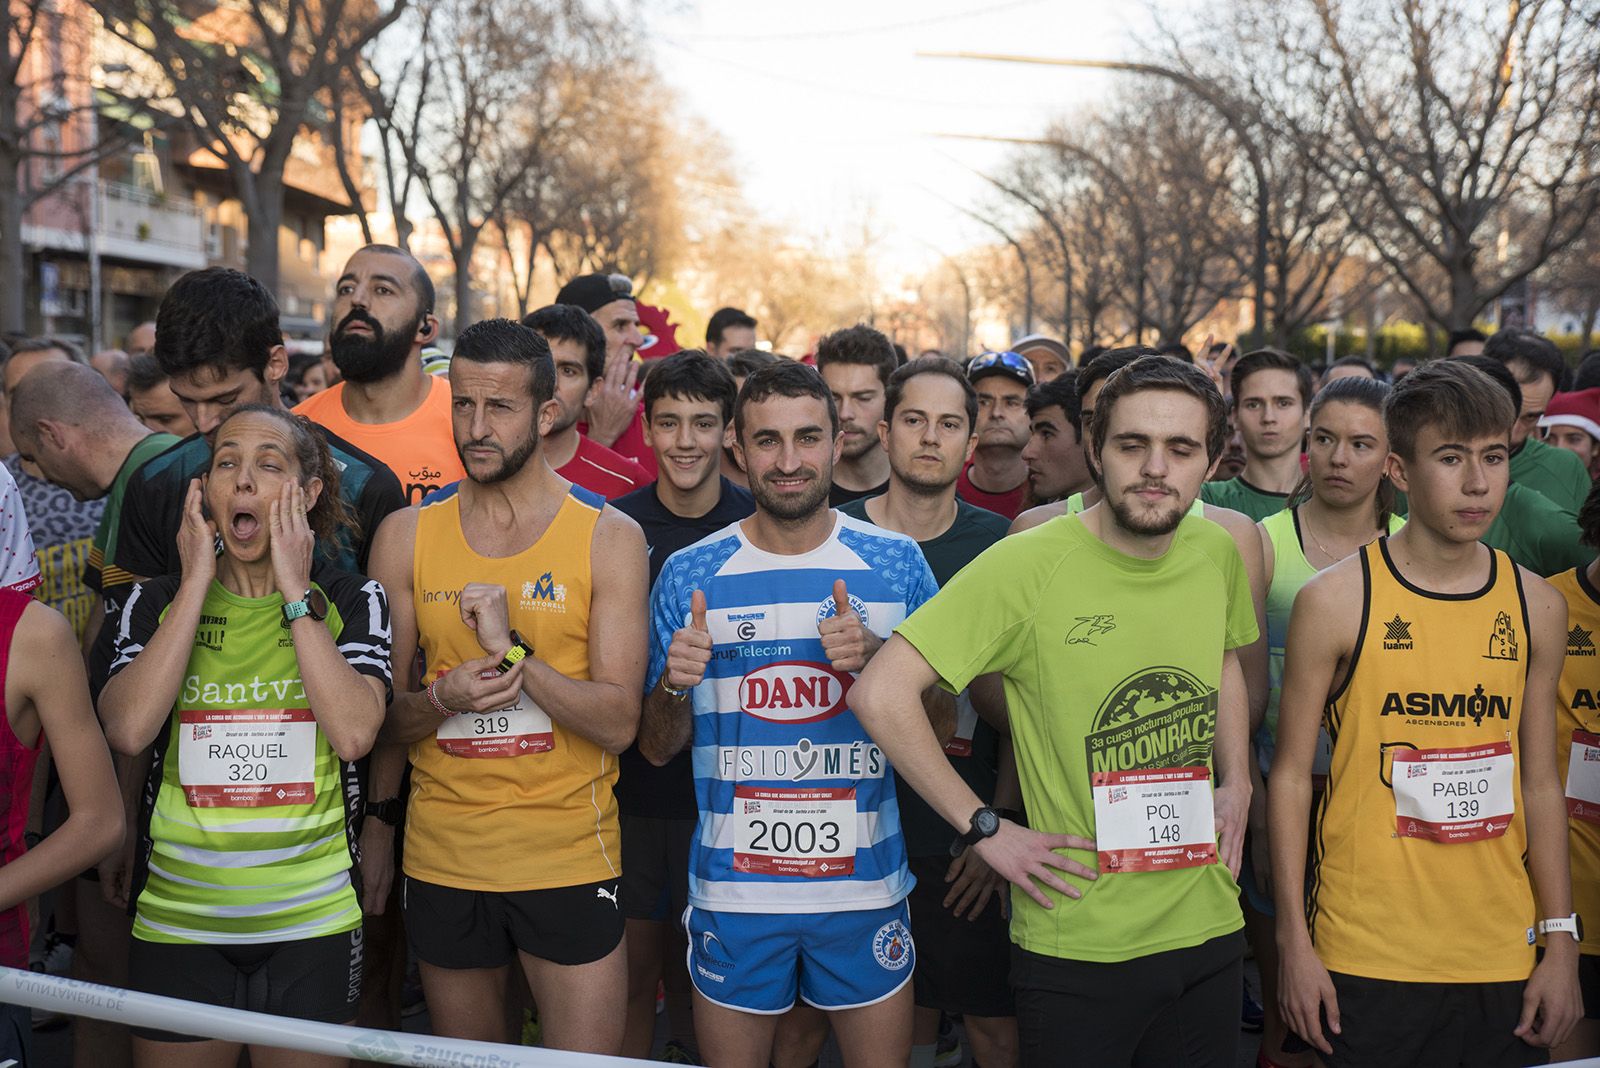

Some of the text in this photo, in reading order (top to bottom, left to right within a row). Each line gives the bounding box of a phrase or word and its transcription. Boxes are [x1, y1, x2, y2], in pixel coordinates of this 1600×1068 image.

[1383, 641, 1413, 650] luanvi
[1565, 647, 1596, 657] uanvi
[746, 676, 832, 709] DANI
[474, 716, 509, 735] 319
[1091, 702, 1204, 749] 3a cursa nocturna popular
[1405, 719, 1466, 727] ASCENSORES
[1092, 709, 1215, 772] MOONRACE
[208, 743, 288, 761] RAQUEL
[824, 741, 880, 775] MÉS
[228, 763, 267, 781] 320
[1433, 779, 1489, 797] PABLO
[1146, 804, 1180, 820] POL
[1447, 800, 1480, 819] 139
[748, 819, 840, 854] 2003
[1149, 824, 1180, 844] 148
